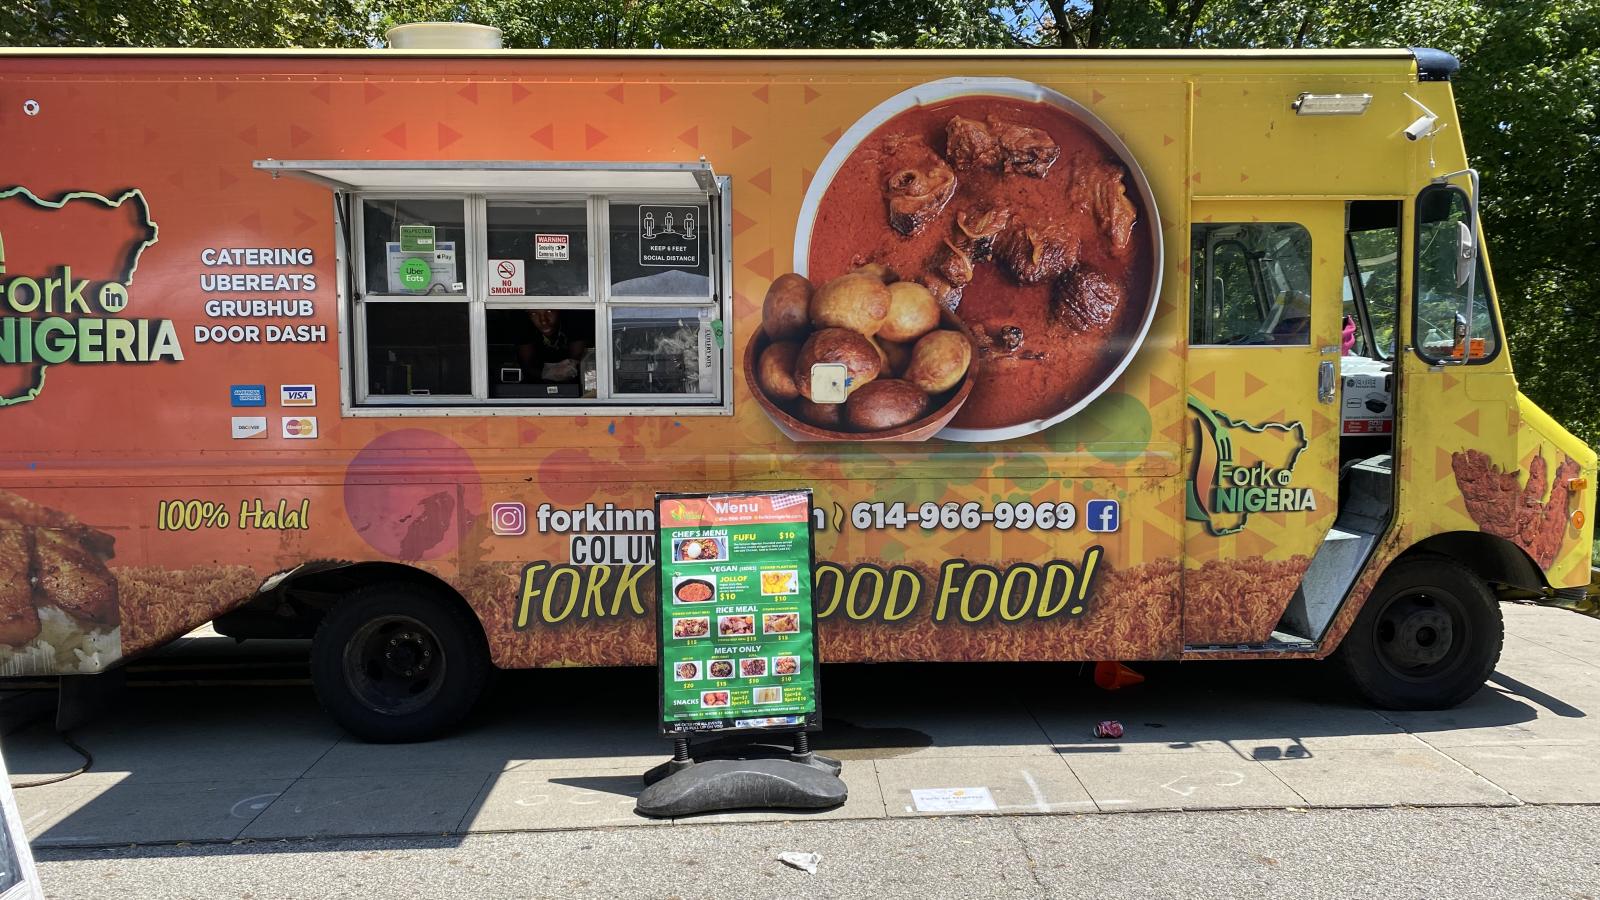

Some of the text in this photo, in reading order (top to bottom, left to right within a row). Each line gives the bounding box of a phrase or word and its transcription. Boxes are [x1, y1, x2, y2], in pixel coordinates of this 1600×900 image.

[201, 248, 313, 266] CATERING
[441, 253, 452, 261] Pay
[406, 267, 424, 275] Uber
[200, 274, 317, 292] UBEREATS
[406, 274, 424, 282] Eats
[105, 287, 123, 307] in
[205, 300, 314, 317] GRUBHUB
[194, 325, 326, 343] DOOR DASH
[288, 392, 308, 400] VISA
[1219, 460, 1275, 486] Fork
[1216, 487, 1317, 512] NIGERIA
[715, 502, 758, 514] Menu
[158, 498, 310, 531] 100% Halal
[851, 501, 1077, 530] 614-966-9969
[672, 529, 728, 538] CHEF'S MENU
[733, 533, 757, 541] FUFU
[779, 531, 795, 540] $10
[710, 565, 738, 573] VEGAN
[719, 575, 748, 583] JOLLOF
[935, 549, 1100, 622] FOOD!
[517, 563, 654, 628] FORK
[719, 592, 736, 602] $10
[715, 606, 734, 614] RICE
[735, 605, 758, 613] MEAL
[738, 645, 762, 653] ONLY
[673, 698, 699, 706] SNACKS
